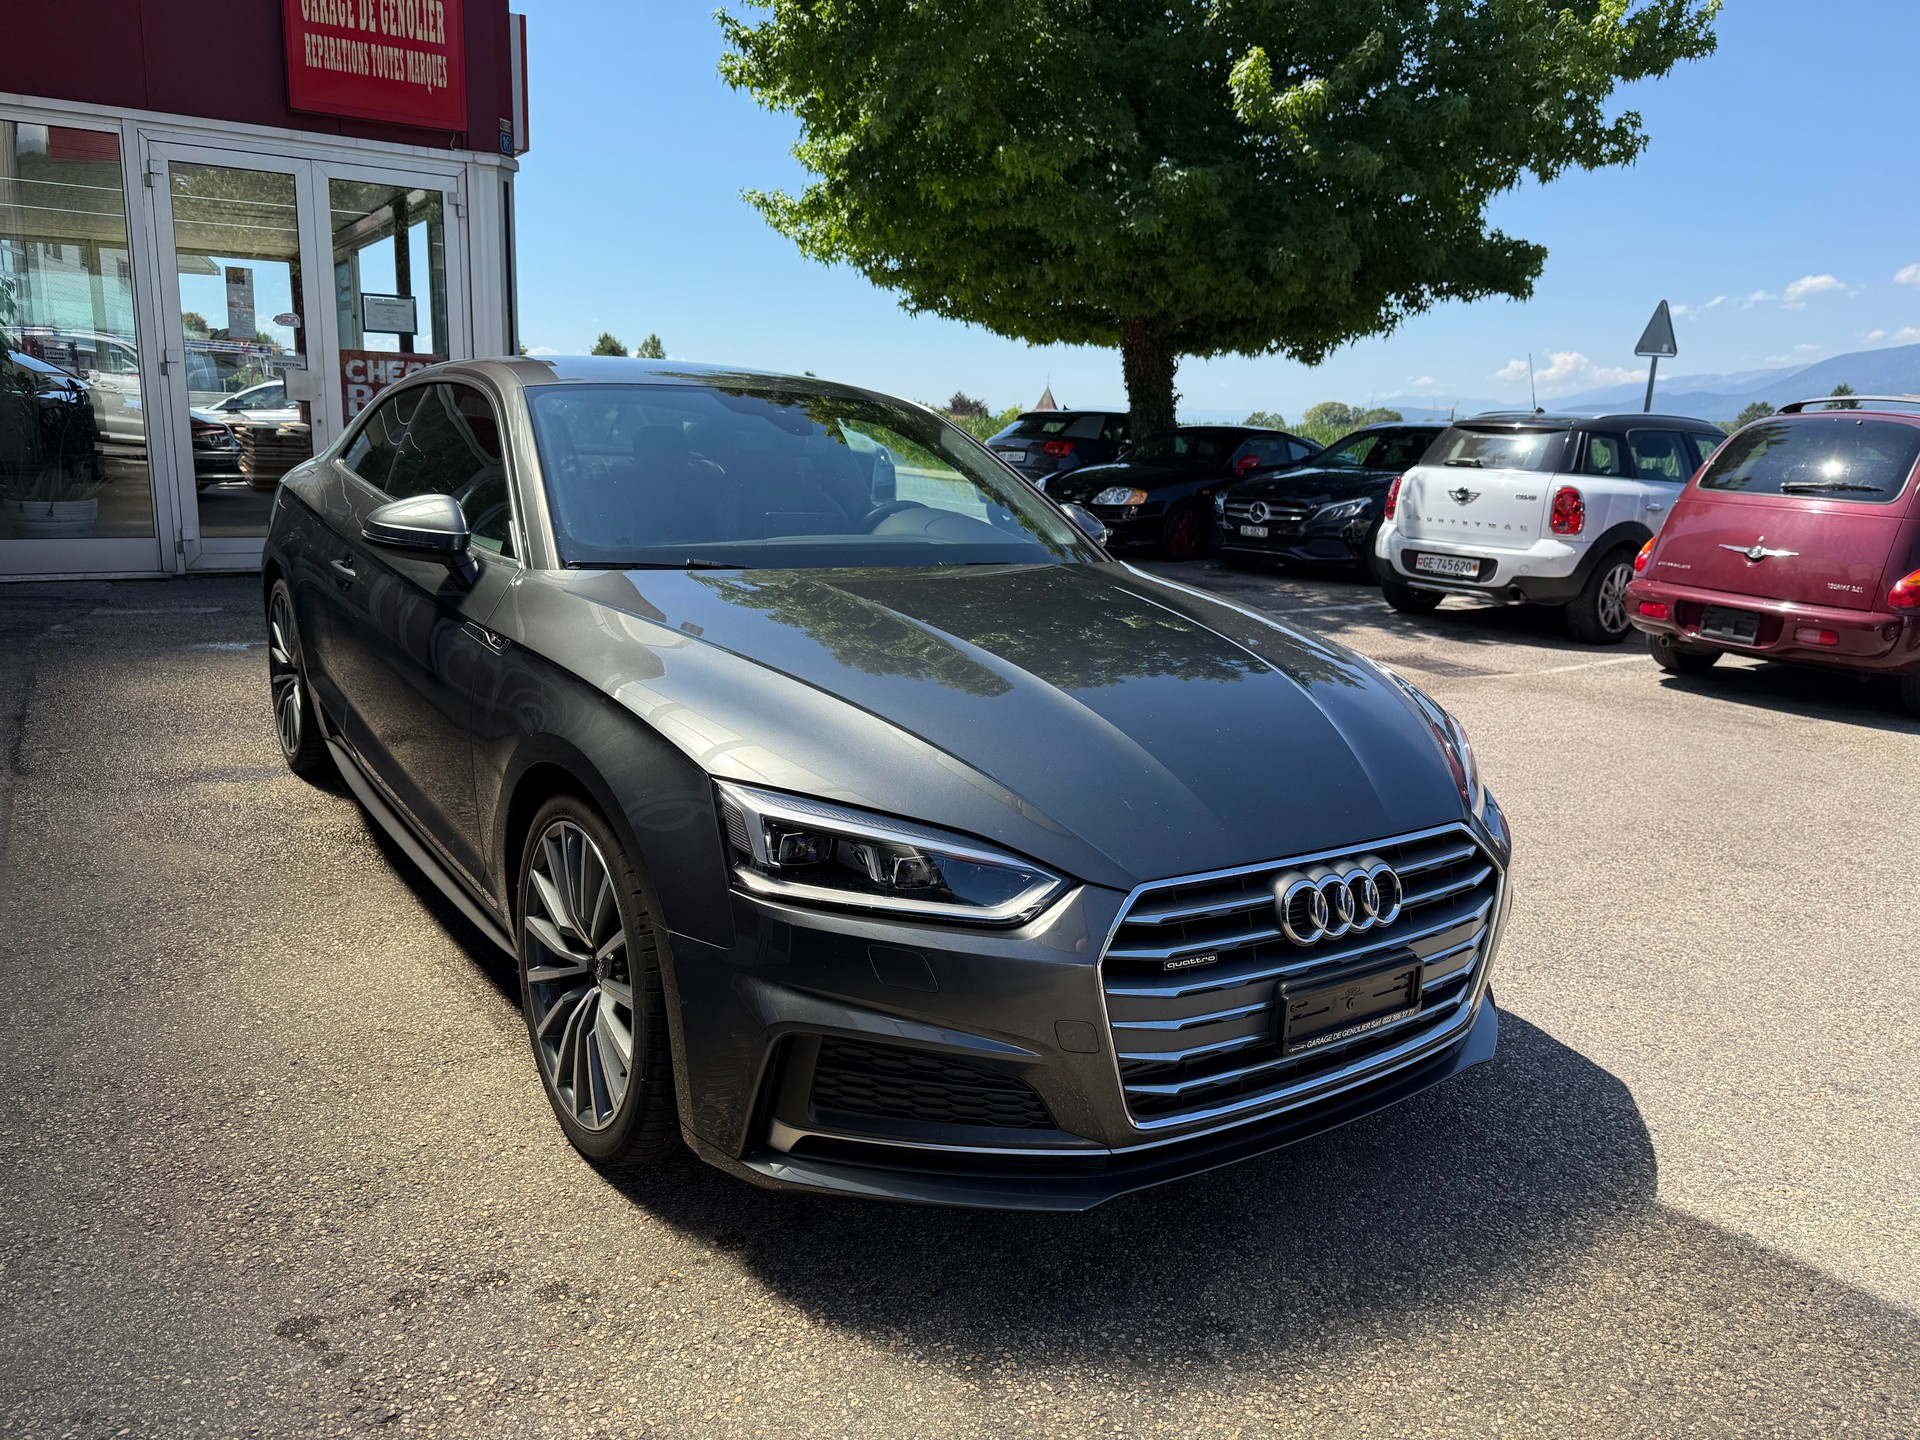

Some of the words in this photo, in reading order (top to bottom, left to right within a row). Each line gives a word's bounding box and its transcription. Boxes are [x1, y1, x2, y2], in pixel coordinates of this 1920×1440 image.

[379, 0, 445, 45] GENOLIER
[304, 32, 369, 76] REPARATIONS
[371, 44, 404, 81] TOUTES
[406, 50, 448, 95] MARQUES
[1167, 955, 1216, 969] quattro
[1307, 1035, 1333, 1048] GARAGE
[1333, 1031, 1342, 1040] DE
[1342, 1023, 1371, 1037] GENOLIER
[1382, 1016, 1391, 1024] 022
